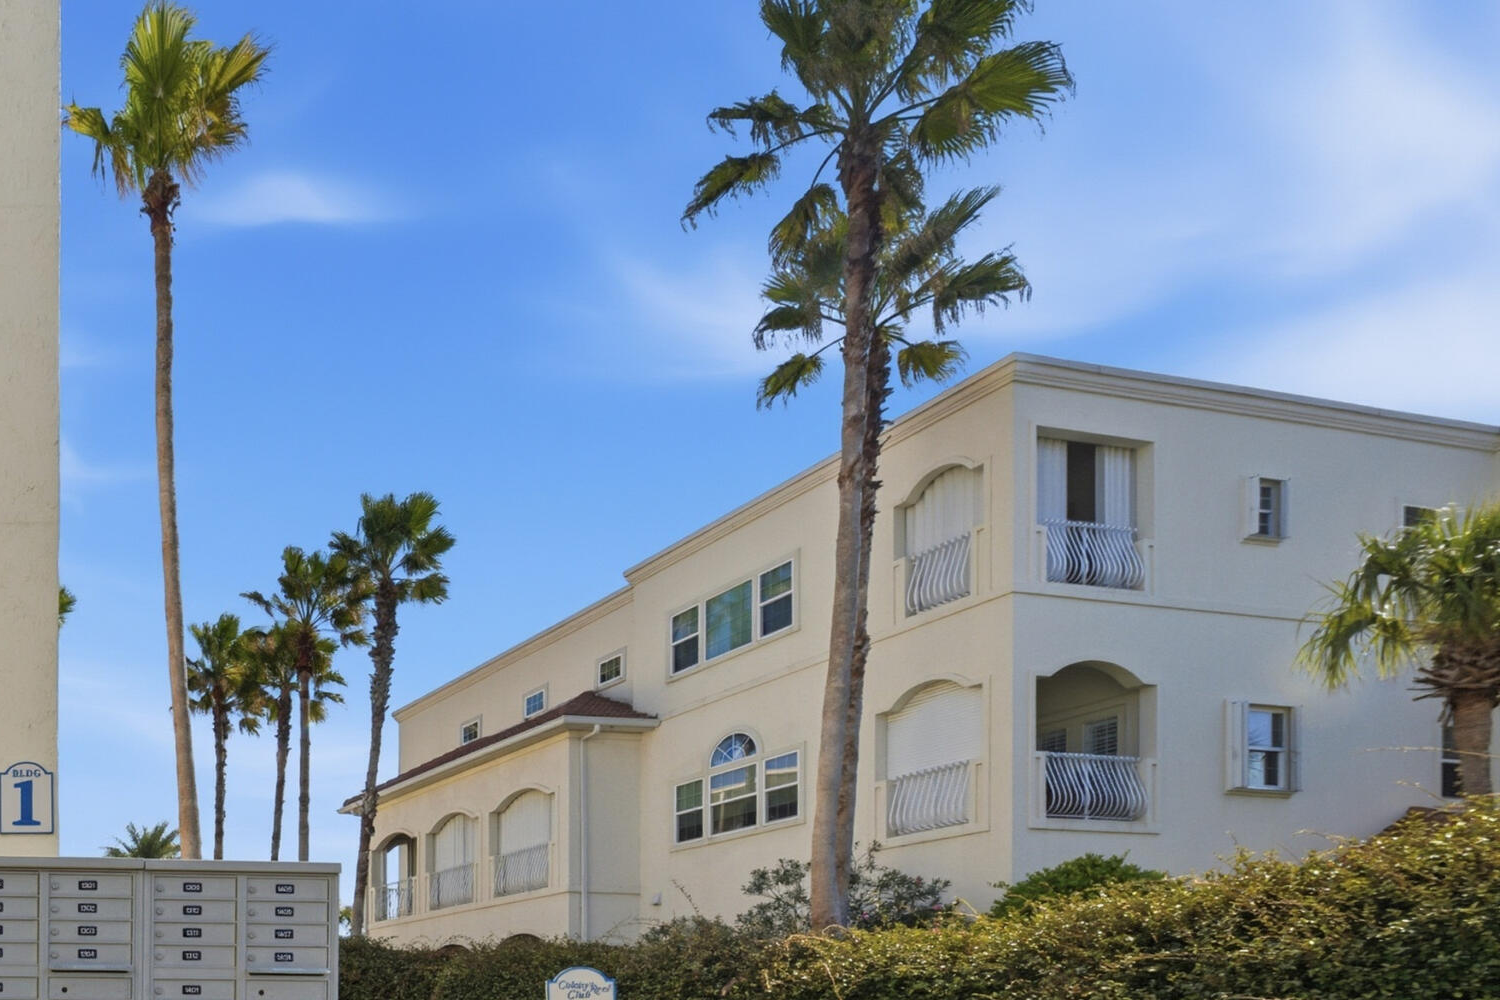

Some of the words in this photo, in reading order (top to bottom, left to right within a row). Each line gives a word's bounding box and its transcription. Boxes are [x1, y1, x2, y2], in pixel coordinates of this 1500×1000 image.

[12, 769, 41, 778] BLDG
[12, 779, 41, 826] 1
[567, 990, 591, 1000] Club
